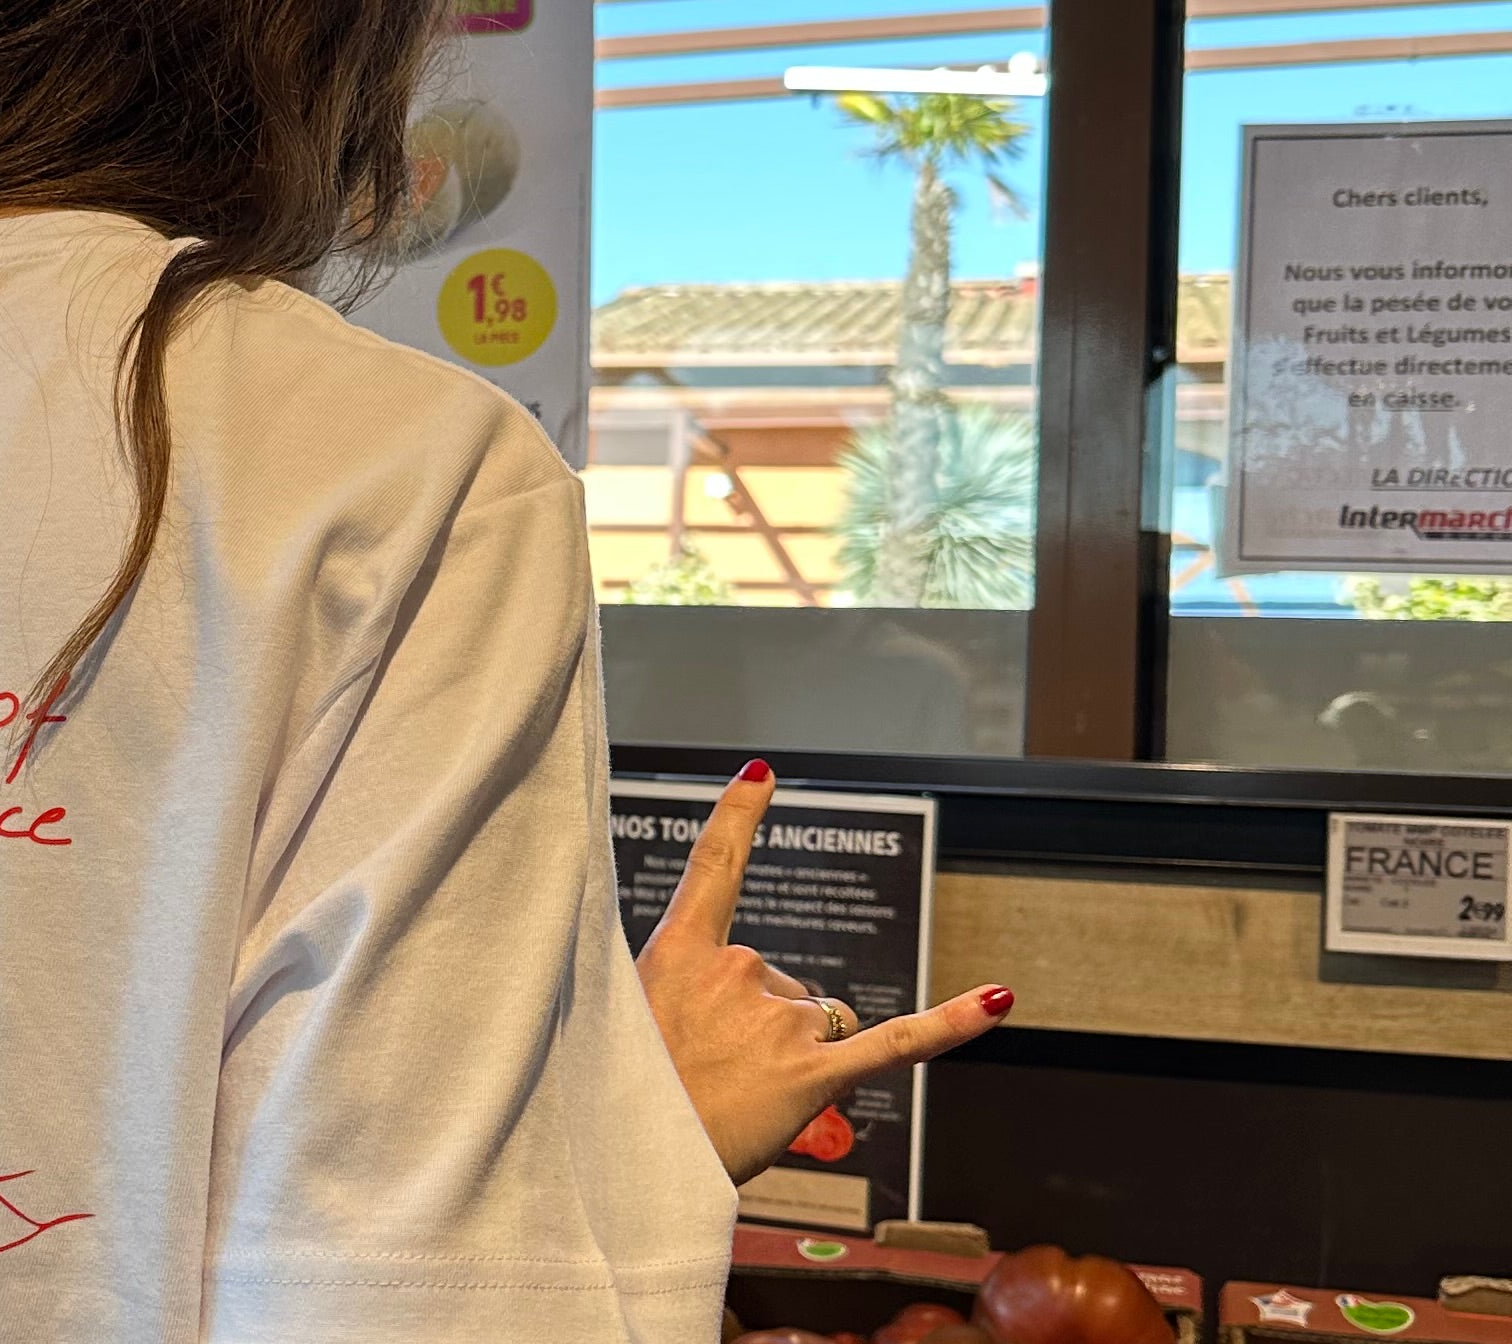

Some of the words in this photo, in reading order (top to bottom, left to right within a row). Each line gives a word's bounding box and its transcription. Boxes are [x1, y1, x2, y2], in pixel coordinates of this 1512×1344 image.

[1332, 187, 1397, 207] Chers
[1404, 186, 1488, 207] clients,
[1284, 263, 1344, 282] Nous
[1350, 263, 1405, 281] vous
[1412, 259, 1512, 280] informo
[1293, 297, 1337, 316] que
[1343, 293, 1364, 313] la
[1370, 290, 1441, 316] pesée
[1447, 292, 1476, 312] de
[1304, 325, 1369, 344] Fruits
[1375, 327, 1400, 344] et
[1407, 322, 1511, 347] Légumes
[1348, 391, 1376, 407] en
[1383, 387, 1460, 408] caisse.
[1371, 468, 1399, 486] LA
[610, 815, 656, 840] NOS
[768, 825, 903, 856] ANCIENNES
[1346, 846, 1494, 879] FRANCE
